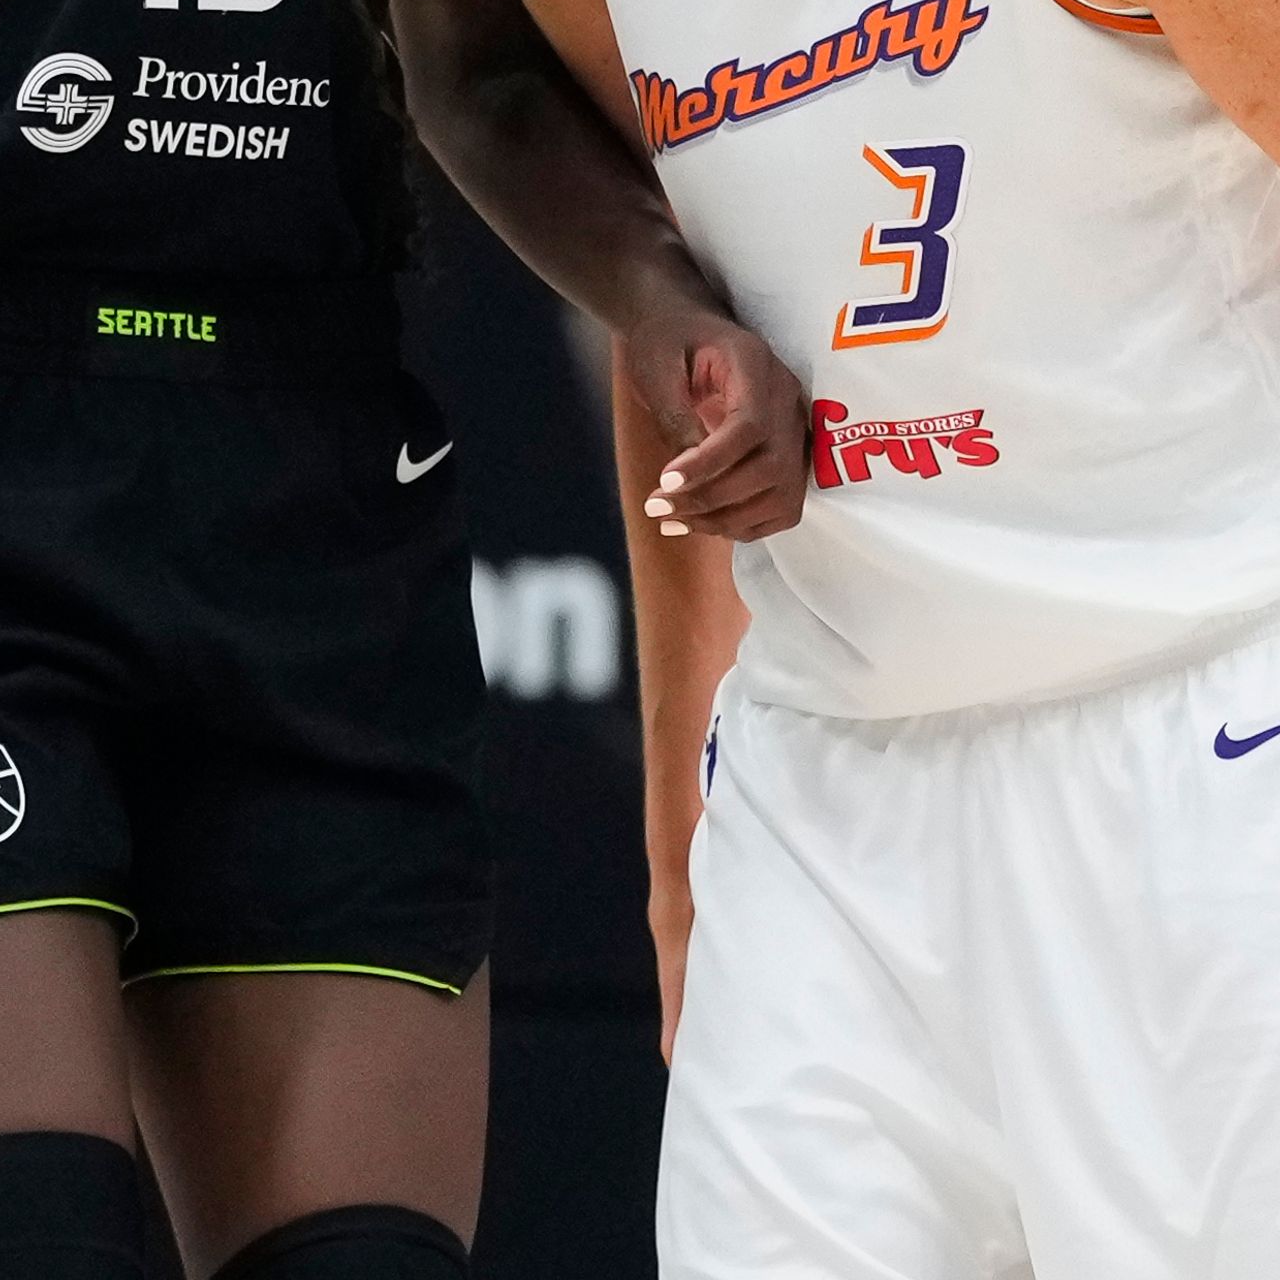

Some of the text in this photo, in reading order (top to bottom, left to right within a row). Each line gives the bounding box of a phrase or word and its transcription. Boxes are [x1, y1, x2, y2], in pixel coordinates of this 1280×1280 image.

[132, 56, 331, 108] Providenc
[123, 118, 291, 160] SWEDISH
[831, 142, 967, 352] 3
[97, 307, 217, 343] SEATTLE
[831, 412, 976, 446] FOOD STORES
